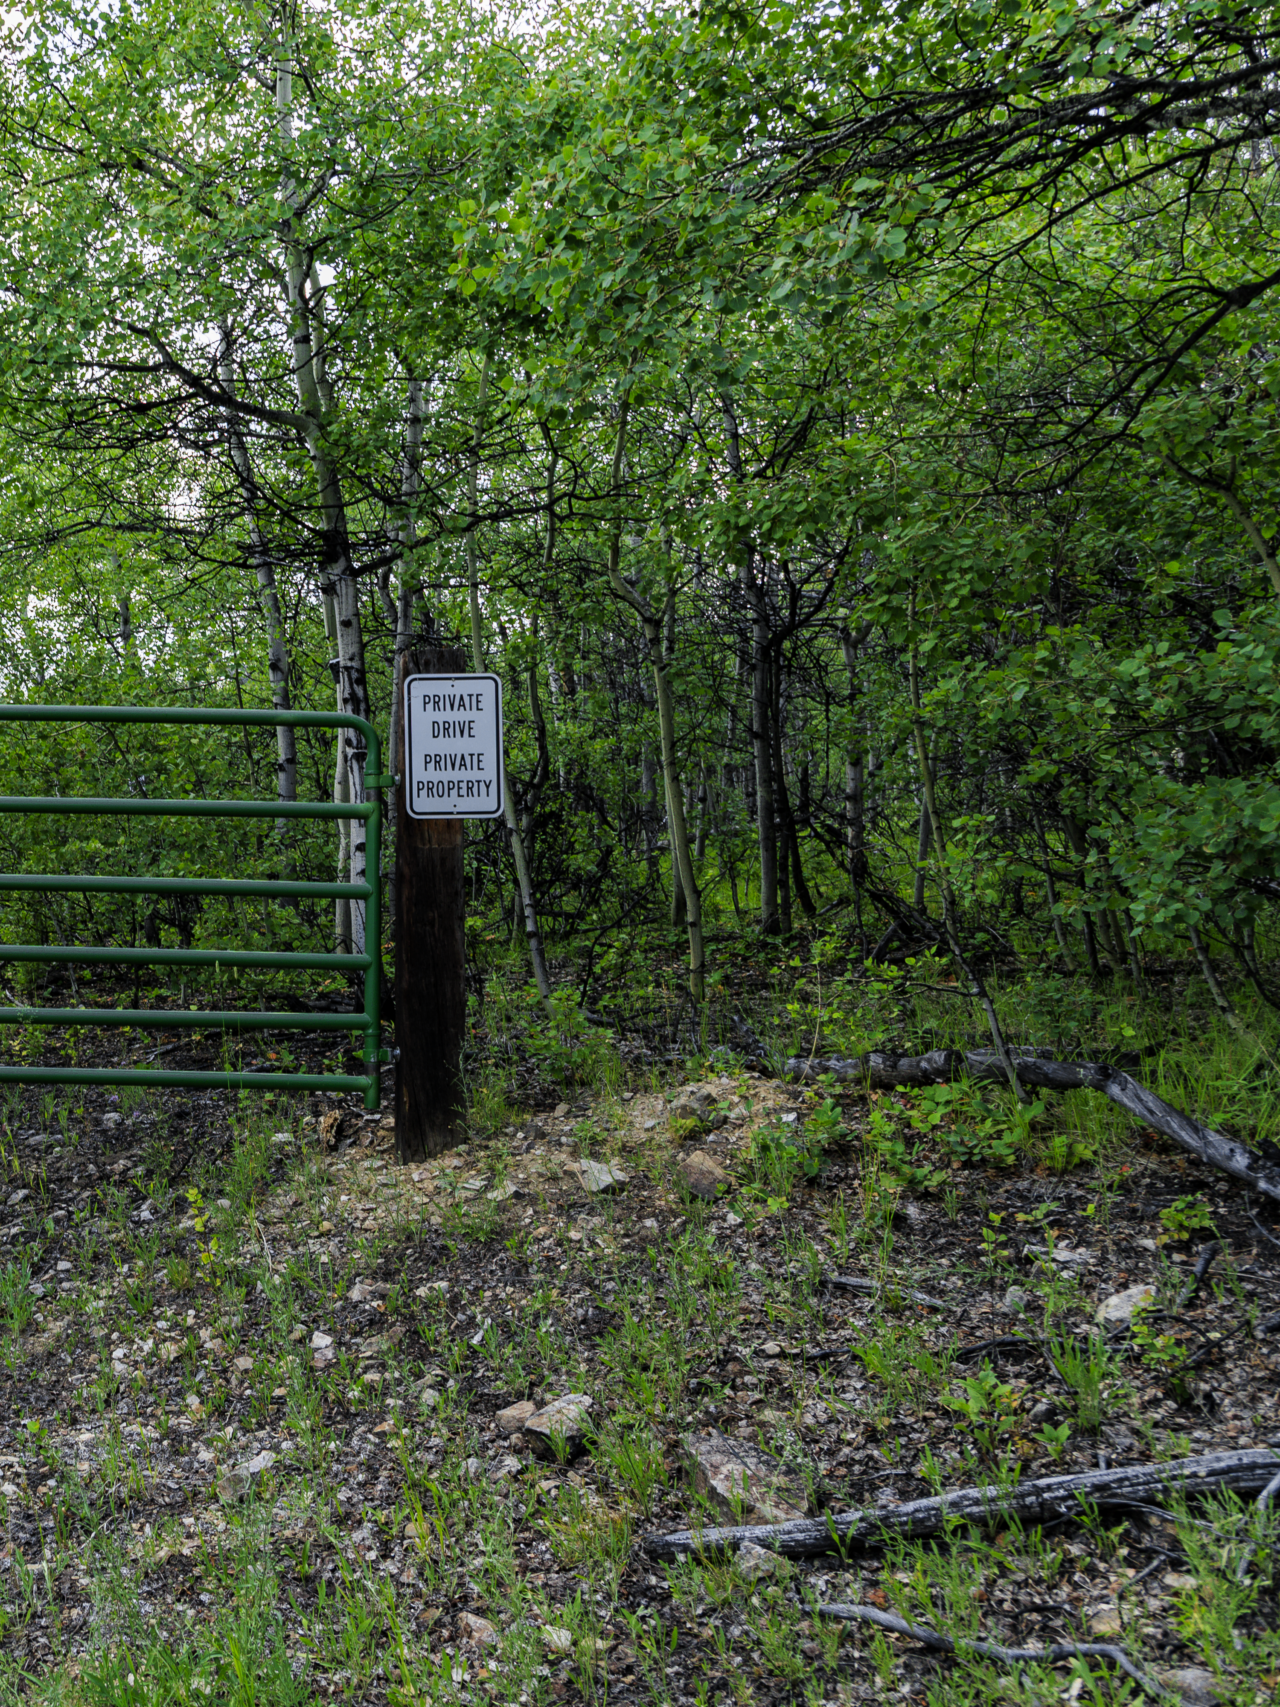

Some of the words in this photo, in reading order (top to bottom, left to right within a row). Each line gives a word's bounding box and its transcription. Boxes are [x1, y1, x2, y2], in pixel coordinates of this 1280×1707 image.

[423, 693, 483, 712] PRIVATE
[432, 720, 476, 739] DRIVE
[424, 753, 485, 772] PRIVATE
[417, 779, 492, 799] PROPERTY
